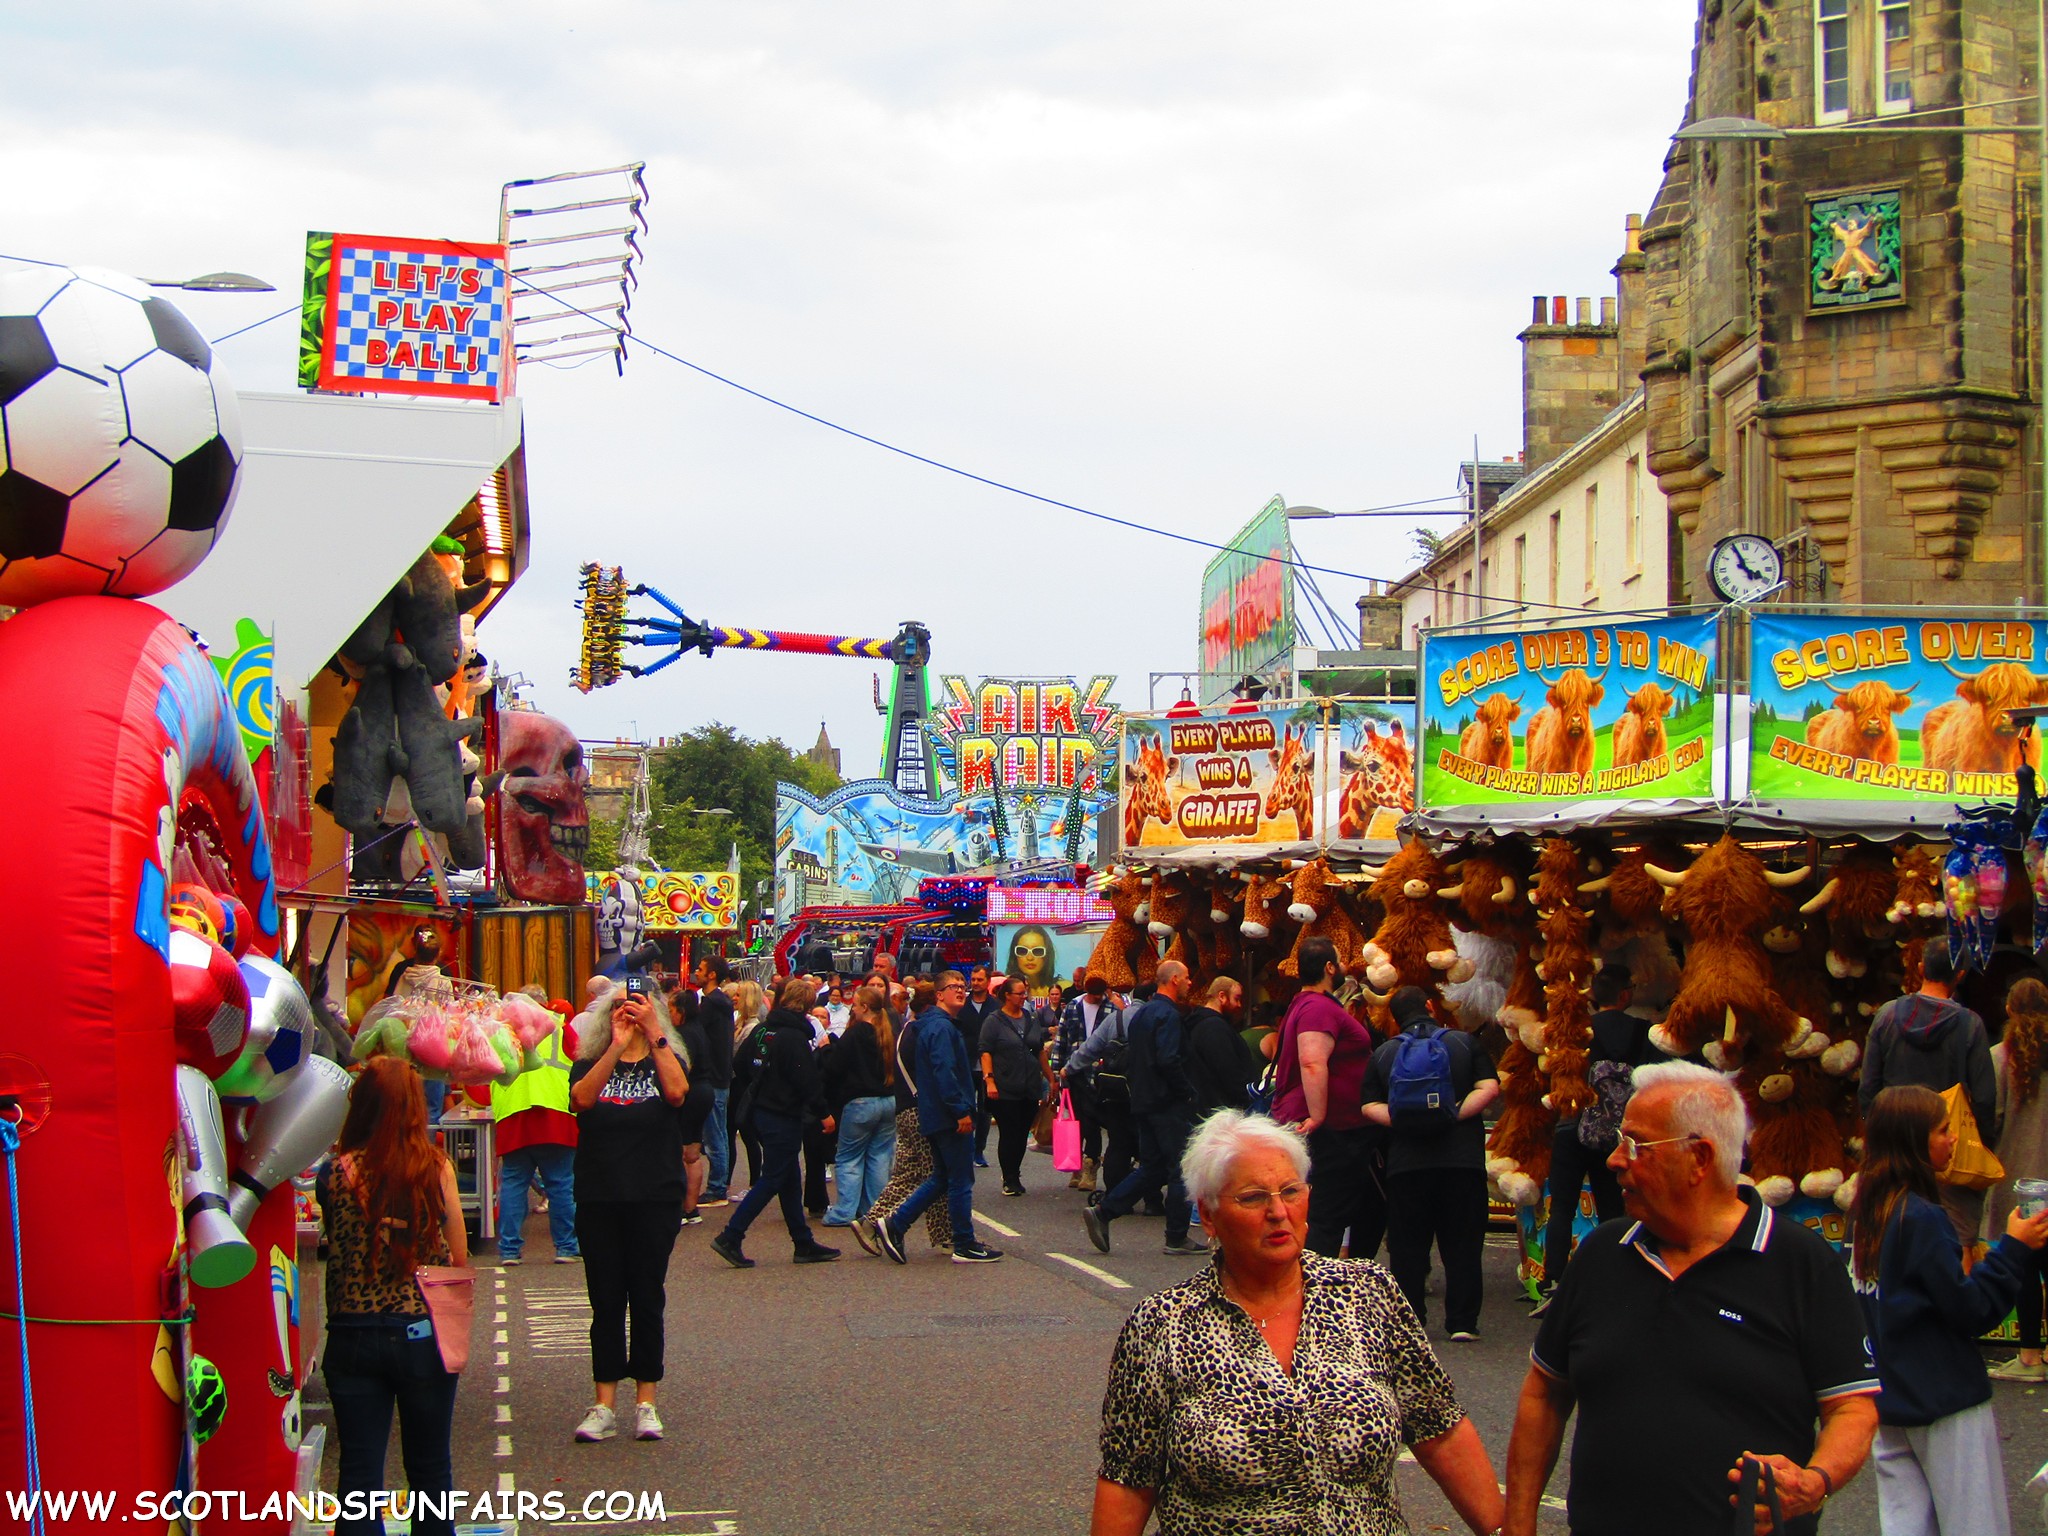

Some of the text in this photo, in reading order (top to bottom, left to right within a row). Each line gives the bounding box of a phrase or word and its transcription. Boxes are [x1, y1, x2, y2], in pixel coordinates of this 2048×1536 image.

[373, 261, 481, 295] LET'S
[376, 300, 477, 333] PLAY
[367, 339, 480, 373] BALL!
[1440, 629, 1708, 706] SCORE OVER 3 TO WIN
[1771, 622, 2034, 690] SCORE OVER
[980, 683, 1080, 735] AIR
[1172, 722, 1273, 748] EVERY PLAYER
[961, 736, 1098, 796] RAID
[1199, 759, 1249, 782] WINS A
[1438, 736, 1705, 796] EVERY PLAYER WINS A HIGHLAND COW
[1769, 735, 1852, 779] EVERY
[1855, 759, 1948, 794] PLAYER
[1953, 771, 2020, 797] WINS
[1181, 799, 1257, 828] GIRAFFE
[788, 861, 828, 880] CABINS
[1719, 1308, 1742, 1321] BOSS
